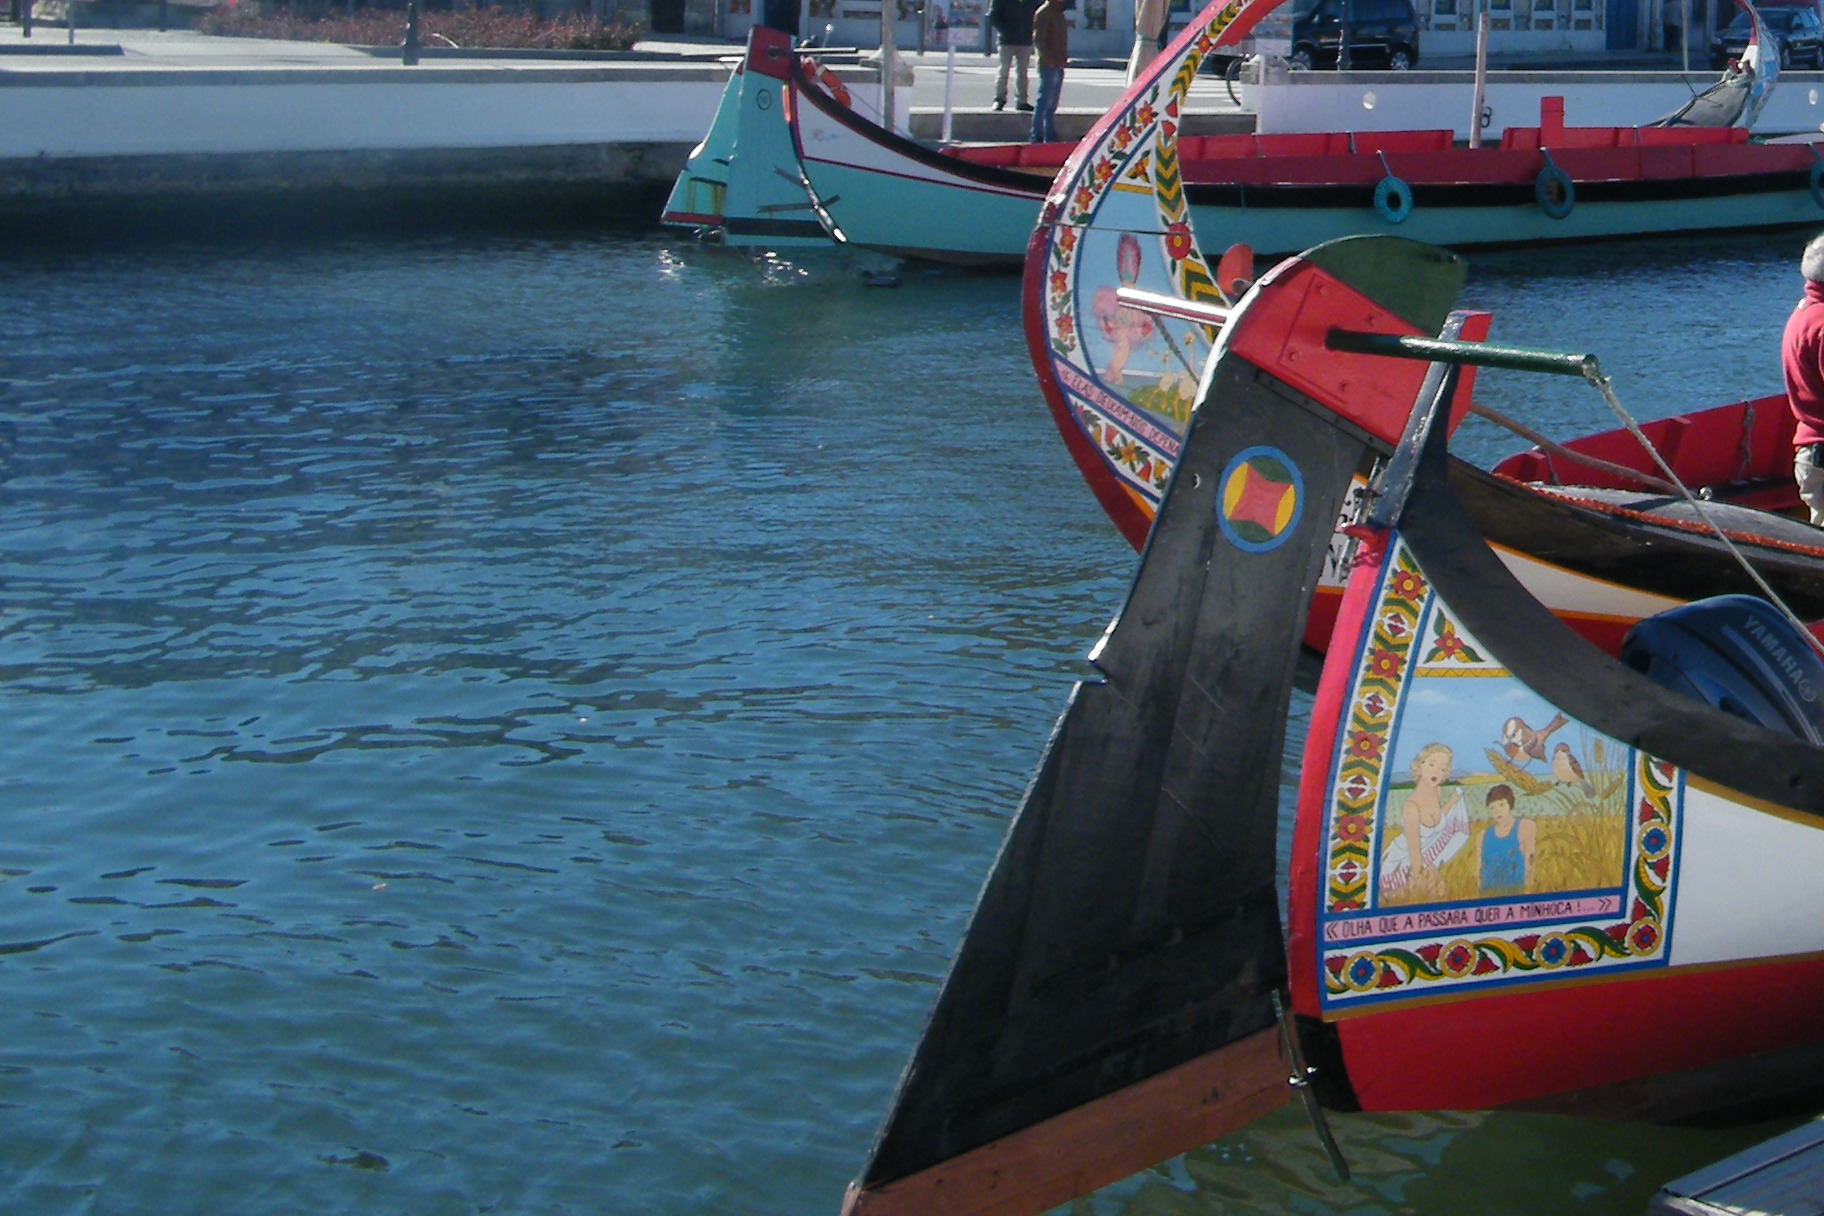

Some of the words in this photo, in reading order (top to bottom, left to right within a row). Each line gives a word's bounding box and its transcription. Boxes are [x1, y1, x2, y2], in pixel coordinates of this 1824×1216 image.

[1743, 615, 1804, 685] YAMAHA
[1341, 920, 1372, 938] OLHA
[1378, 916, 1399, 934] QUE
[1402, 915, 1414, 930] A
[1417, 910, 1468, 928] PASSARA
[1474, 906, 1500, 924] QUER
[1505, 906, 1516, 921] A
